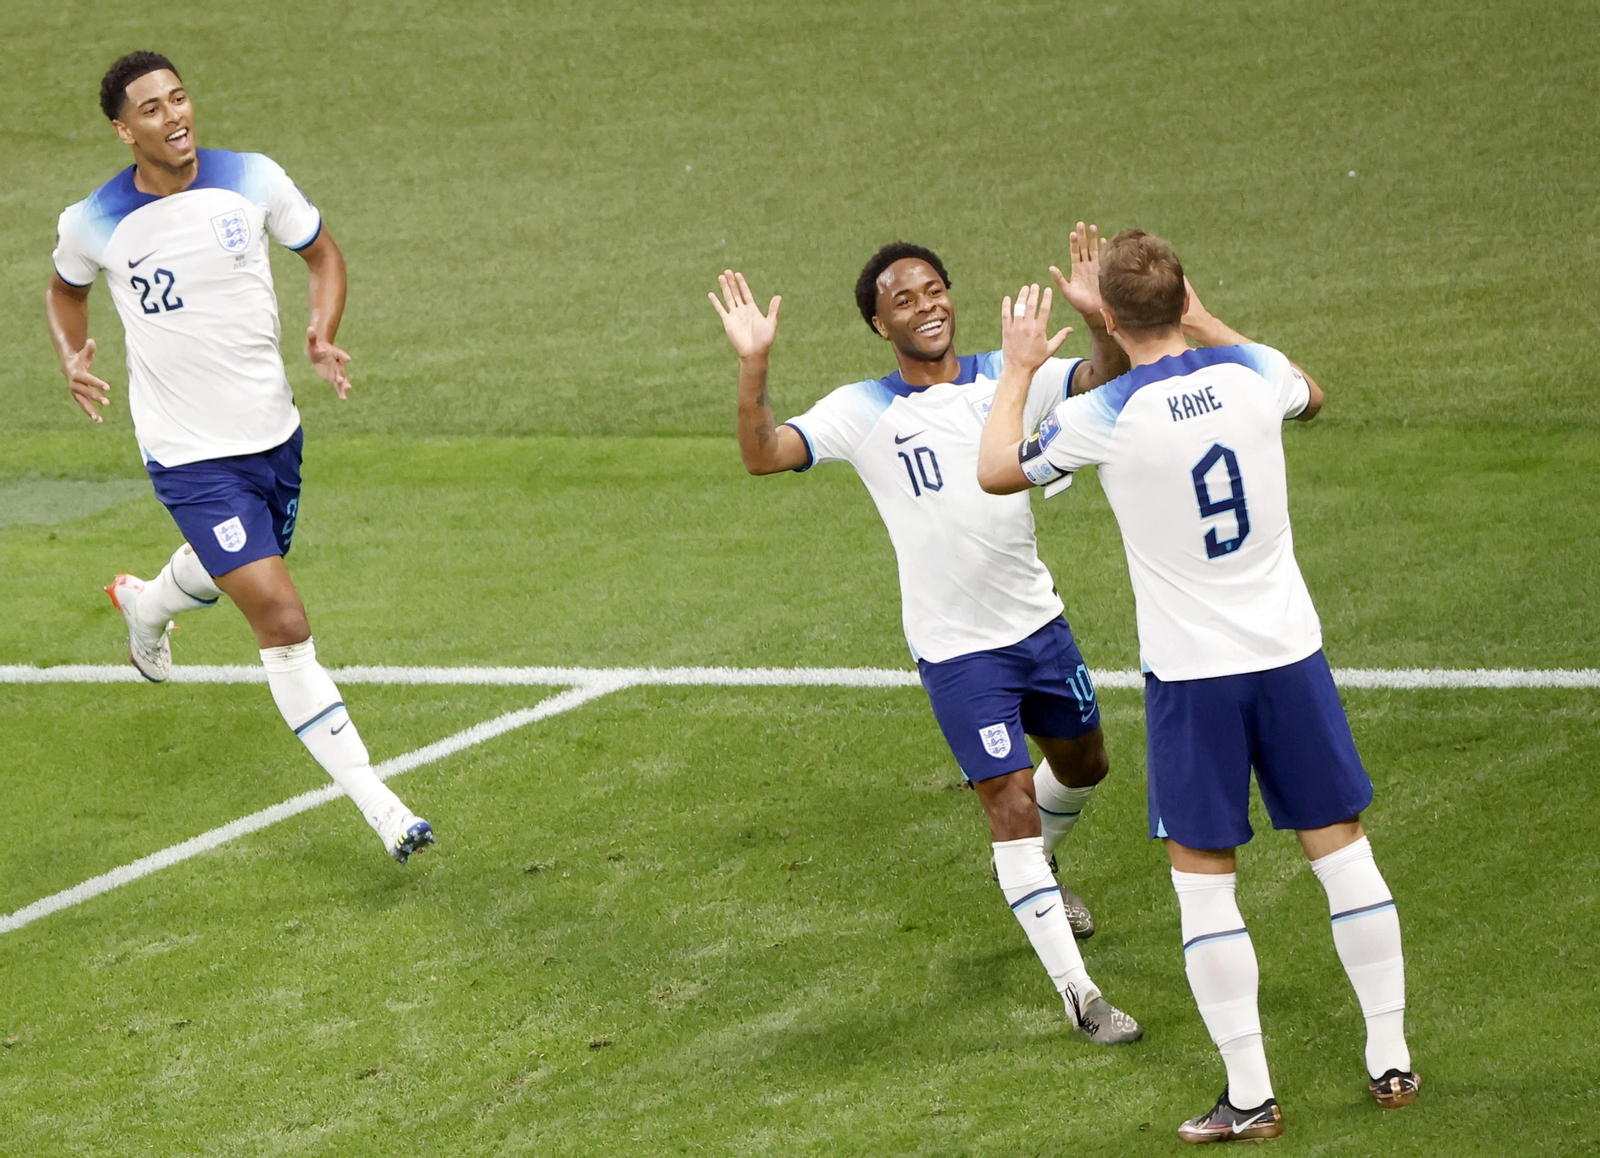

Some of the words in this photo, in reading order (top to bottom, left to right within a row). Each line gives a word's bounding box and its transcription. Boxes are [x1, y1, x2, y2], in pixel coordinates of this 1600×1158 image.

[130, 267, 184, 314] 22
[1167, 386, 1223, 421] KANE
[898, 446, 944, 497] 10
[1191, 442, 1251, 560] 9
[1065, 663, 1094, 711] 10
